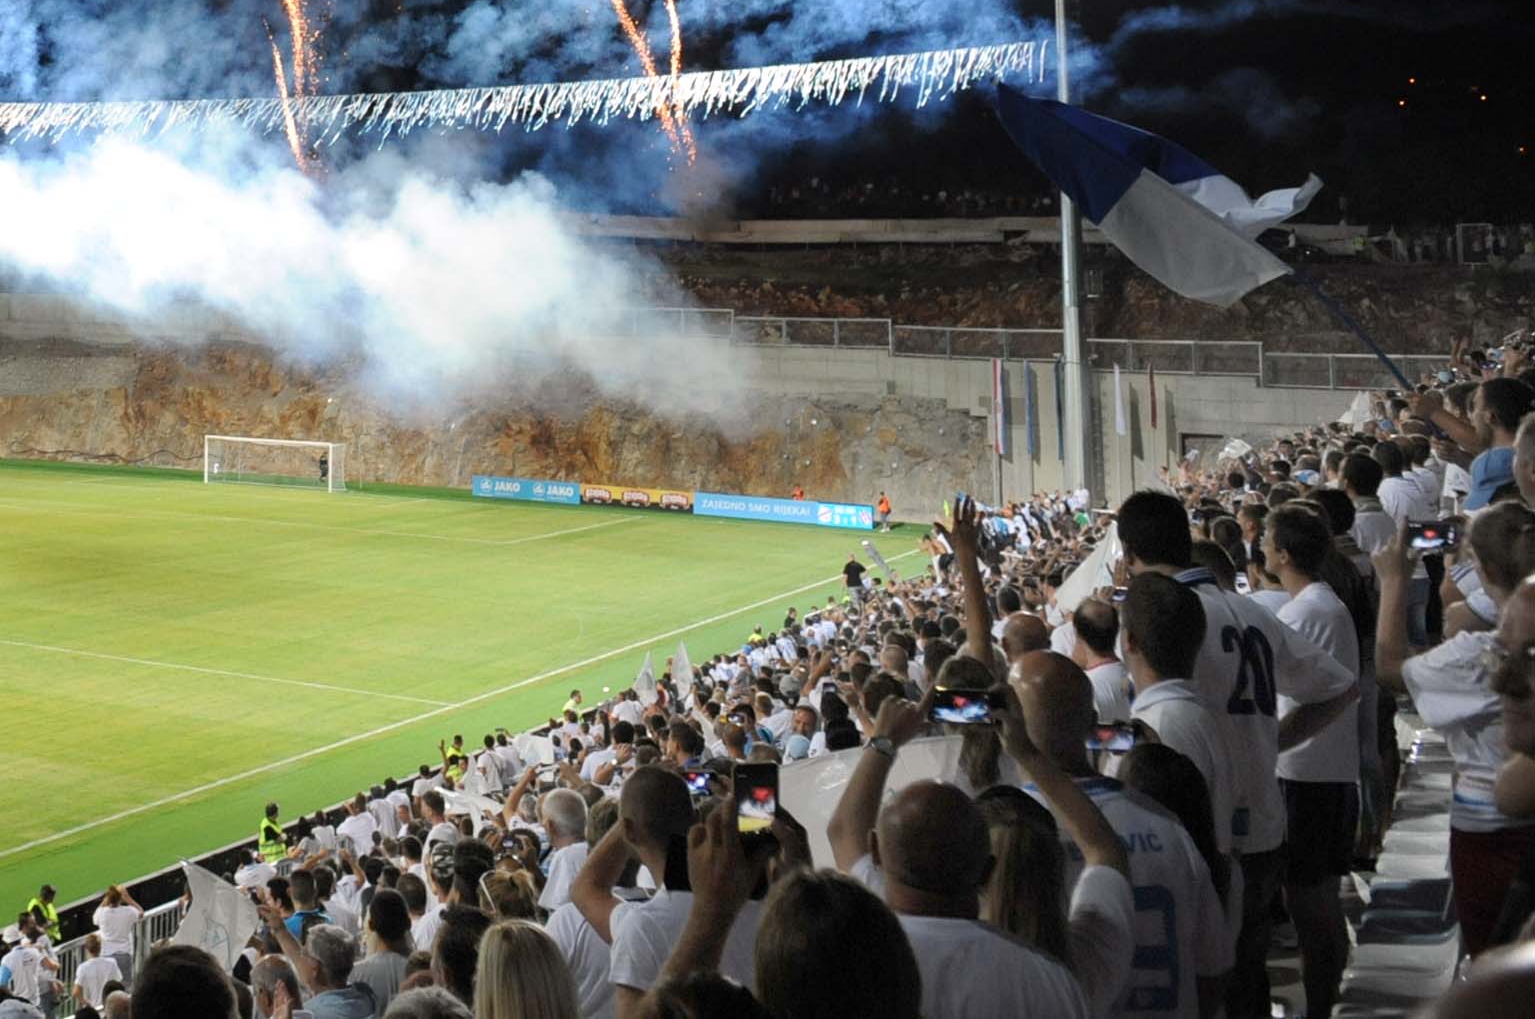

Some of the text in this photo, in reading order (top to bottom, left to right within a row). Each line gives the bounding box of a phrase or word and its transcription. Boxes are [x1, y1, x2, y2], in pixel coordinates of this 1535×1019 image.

[494, 480, 521, 494] JAKO
[546, 484, 574, 498] JAKO
[702, 498, 746, 512] ZAJEDNO
[748, 502, 770, 514] SMO
[1221, 625, 1277, 717] 20
